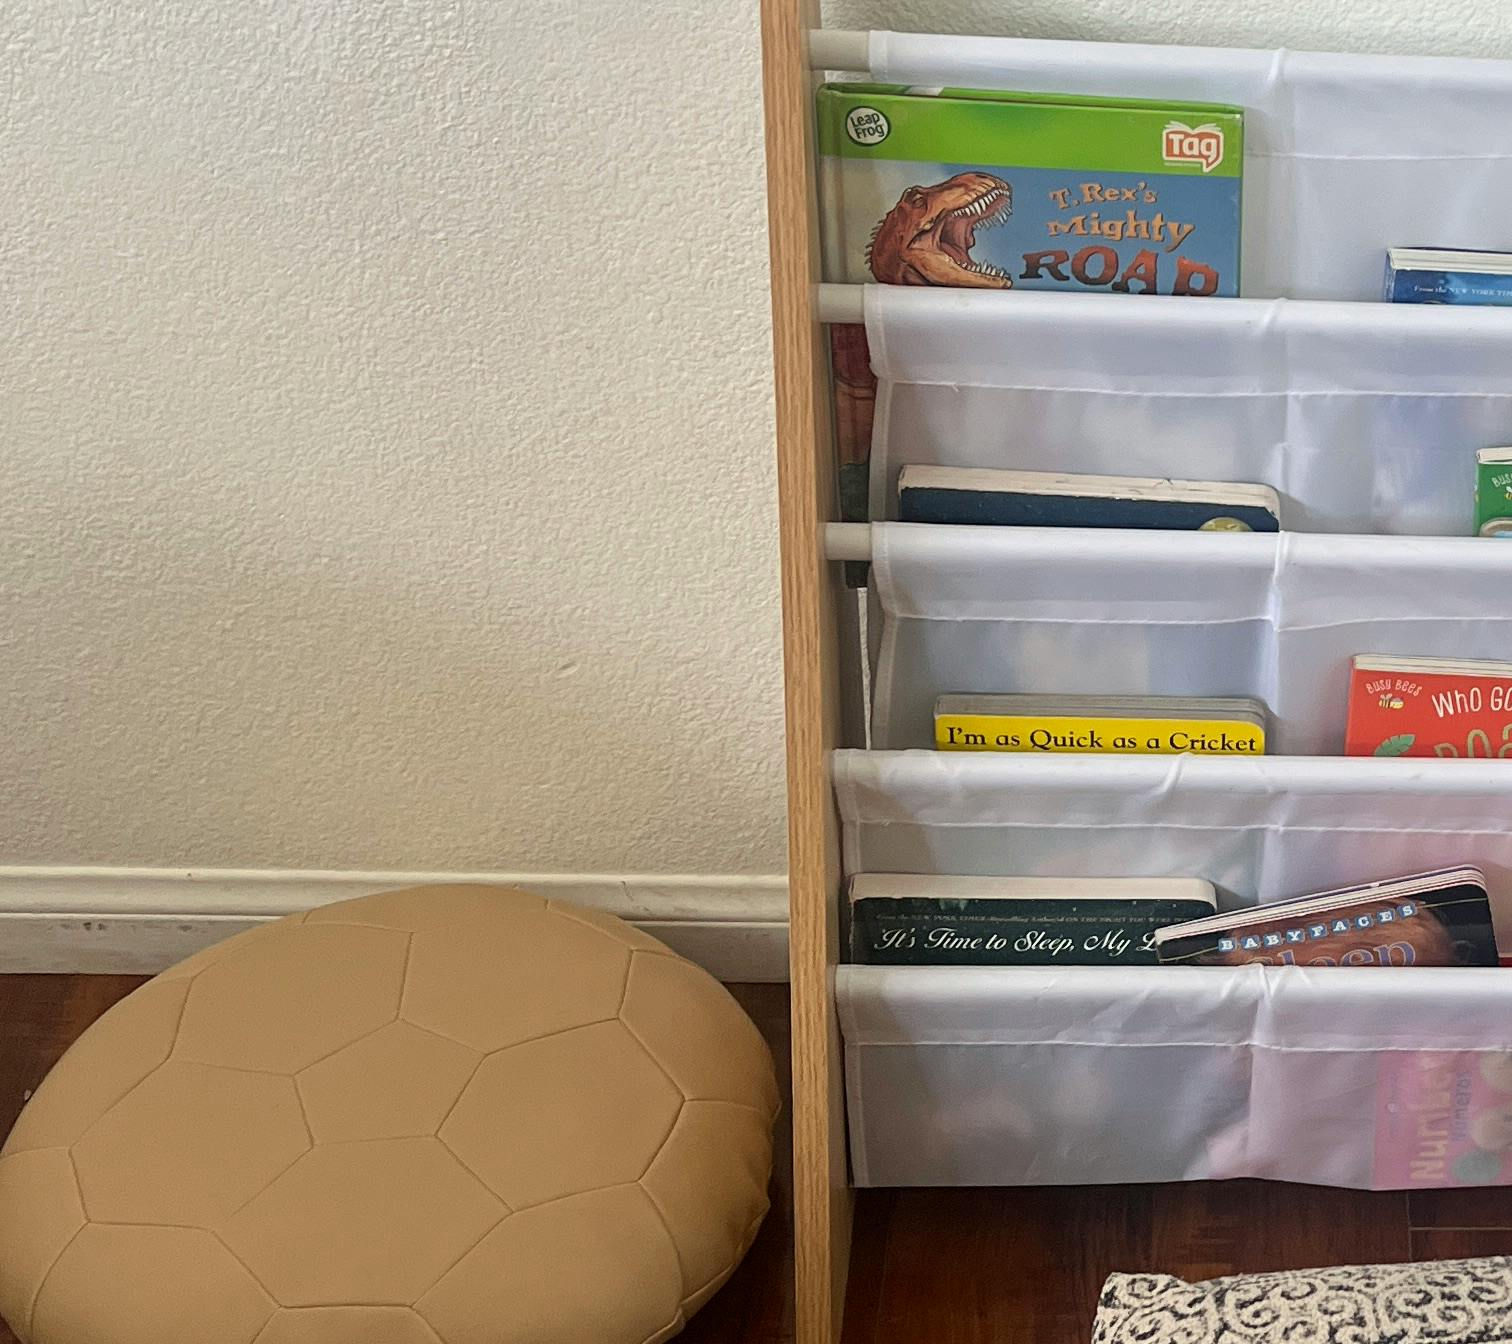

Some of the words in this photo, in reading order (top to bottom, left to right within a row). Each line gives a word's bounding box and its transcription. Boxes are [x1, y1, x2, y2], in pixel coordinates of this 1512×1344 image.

[850, 113, 880, 127] Leap
[854, 124, 885, 139] Frog
[1168, 133, 1218, 164] Tag
[1046, 209, 1196, 253] Mighty
[946, 726, 987, 746] I'm
[995, 733, 1020, 747] as
[1029, 729, 1104, 750] Quick
[1112, 736, 1137, 750] as
[1146, 737, 1160, 750] a
[1169, 731, 1257, 752] Cricket
[923, 927, 983, 949] Time
[984, 933, 1008, 950] to
[1013, 930, 1076, 956] Sleep,
[1083, 928, 1132, 957] My
